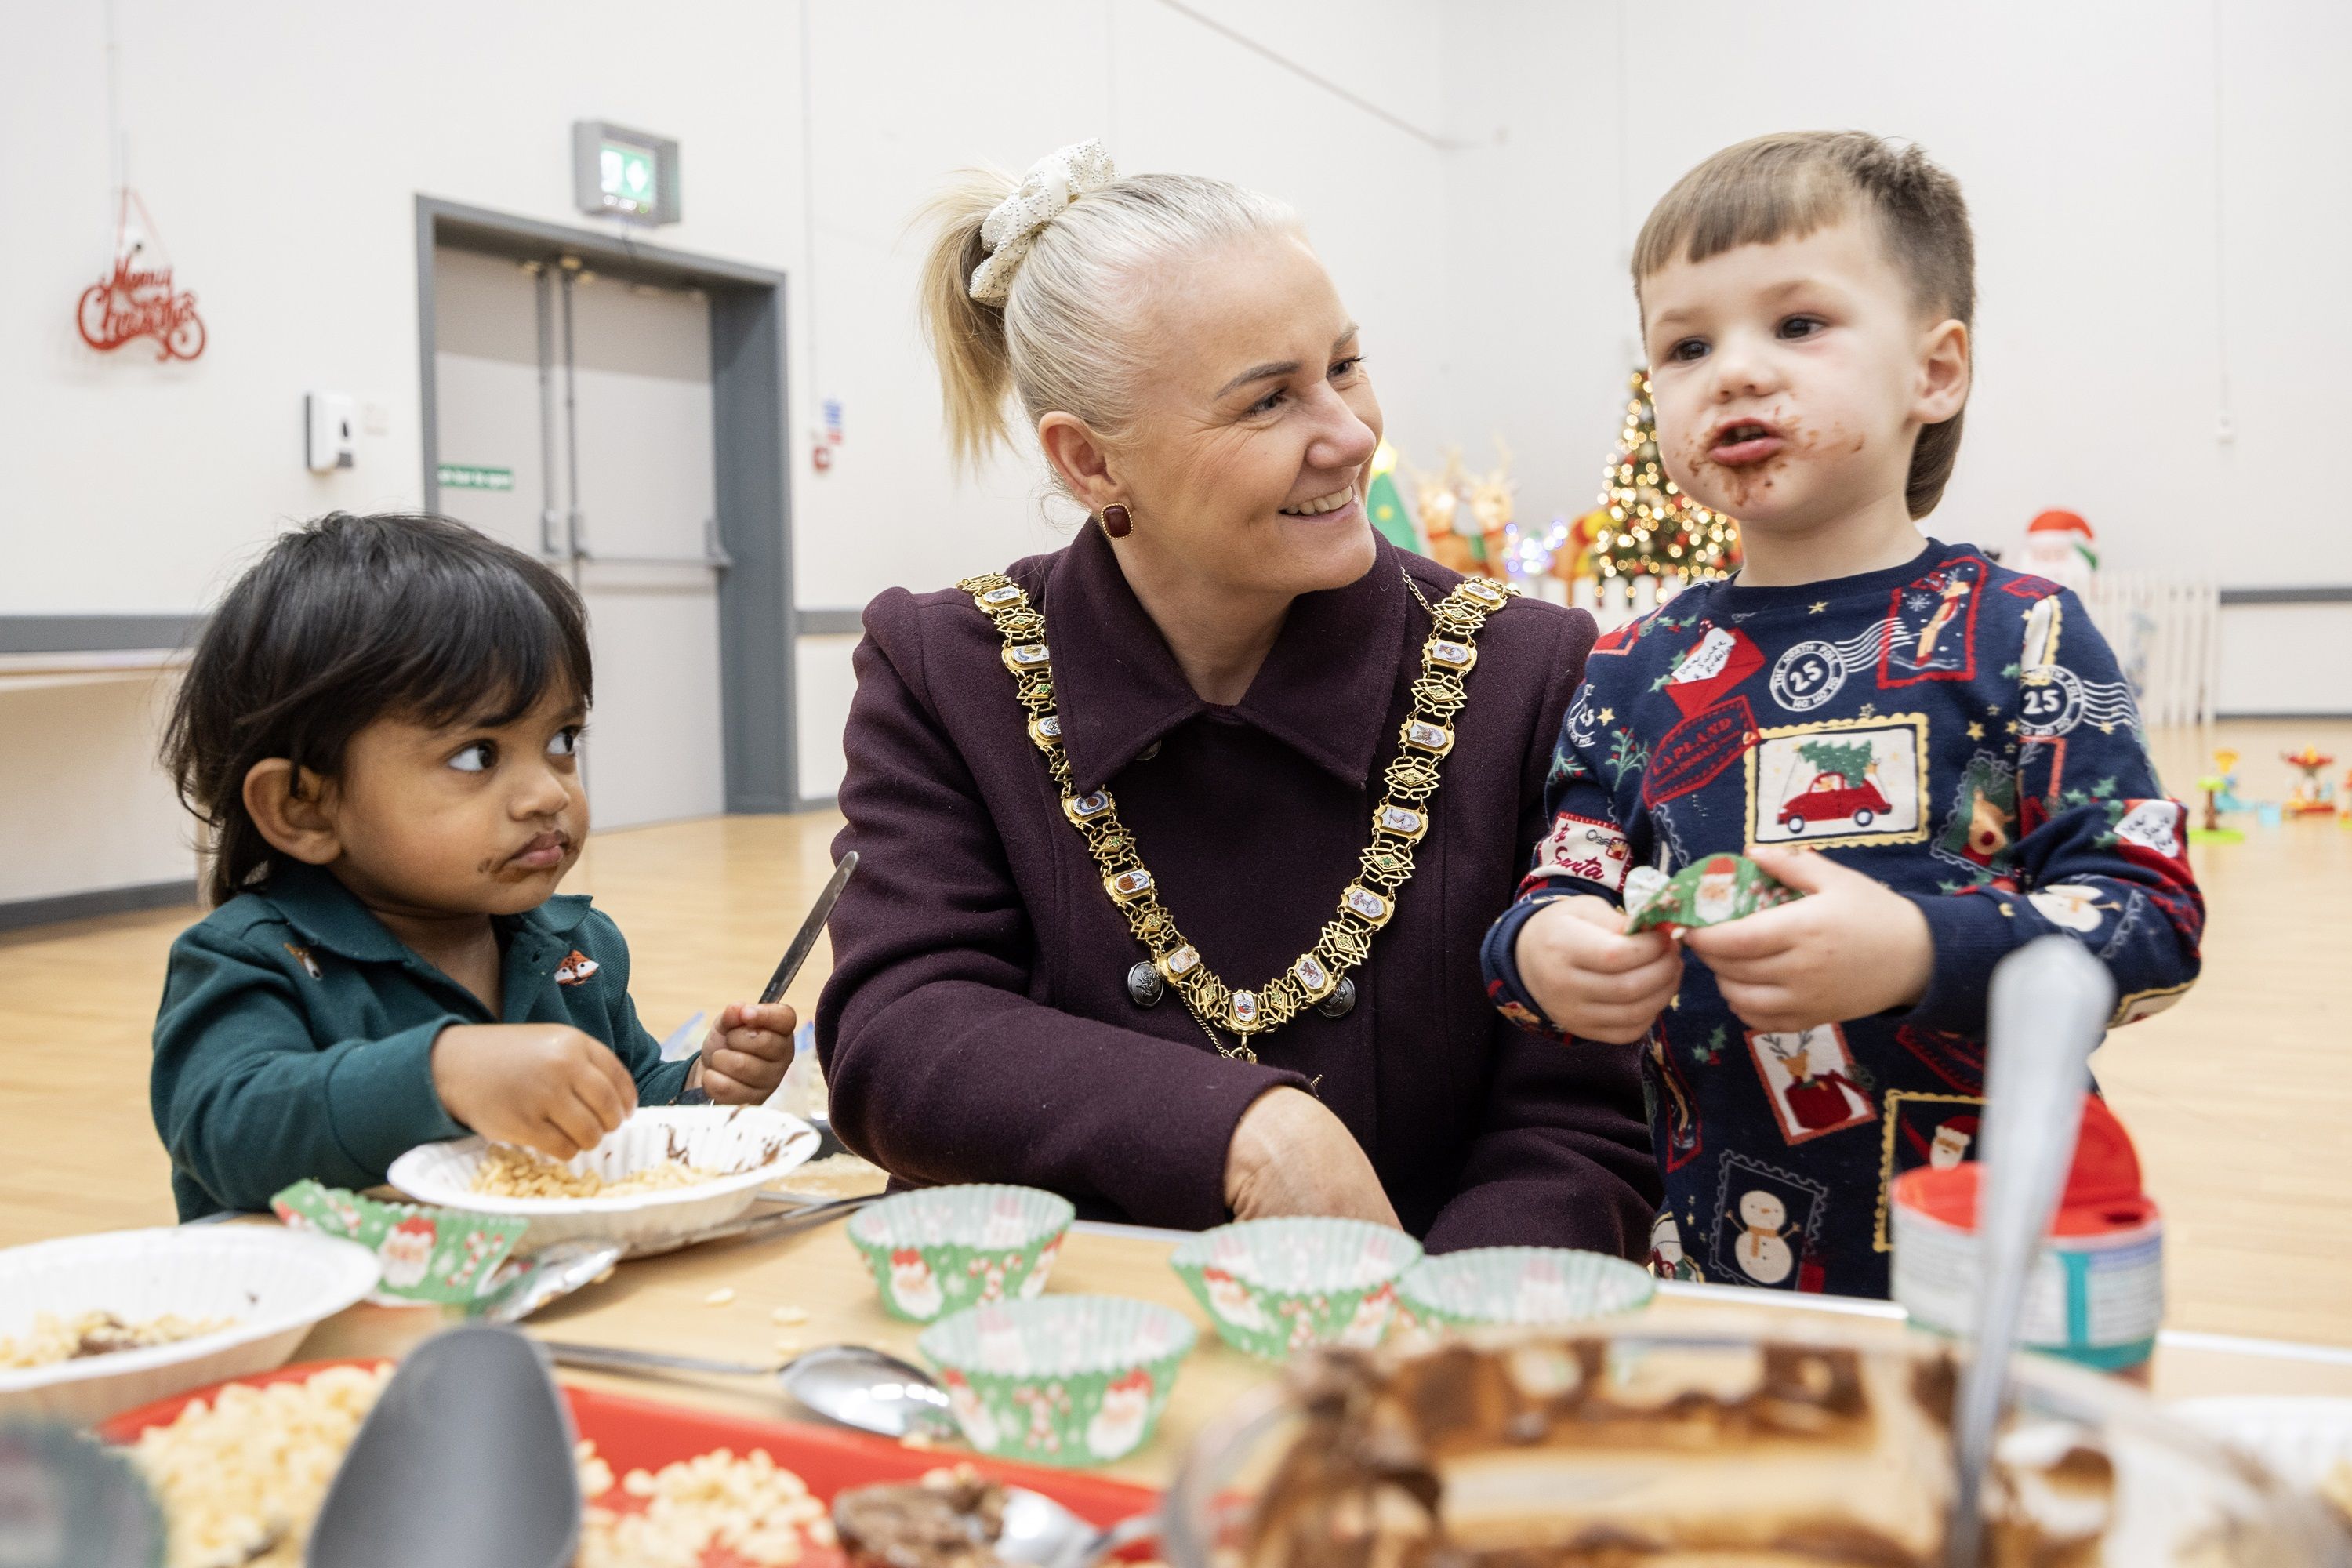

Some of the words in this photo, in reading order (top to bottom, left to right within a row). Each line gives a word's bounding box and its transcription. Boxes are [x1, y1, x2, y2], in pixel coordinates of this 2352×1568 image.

[1782, 644, 1816, 665] NORTH
[1820, 645, 1840, 665] POLE
[1789, 660, 1823, 692] 25
[2023, 689, 2060, 714] 25
[1555, 845, 1605, 880] Santa
